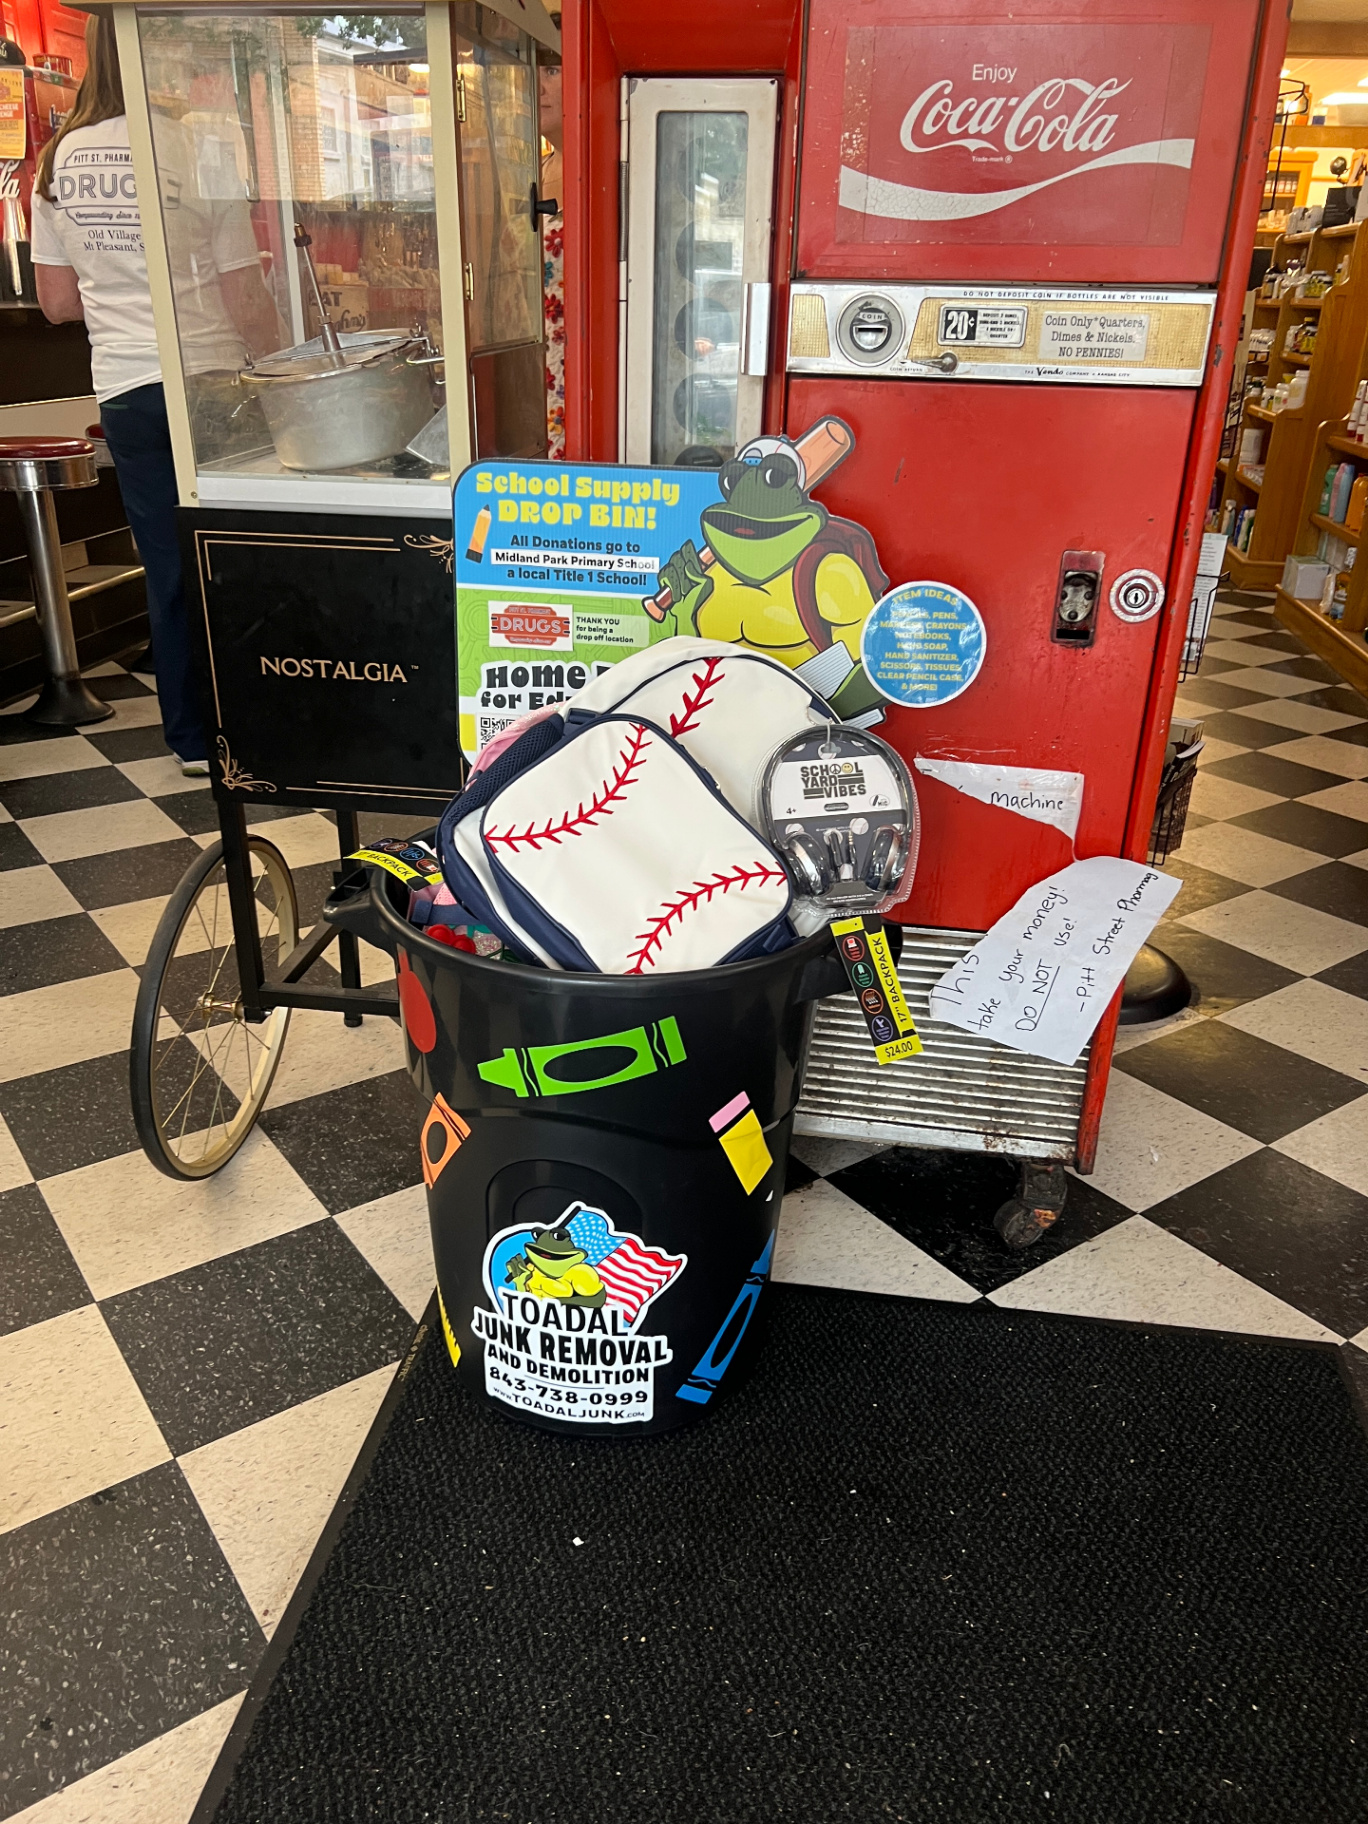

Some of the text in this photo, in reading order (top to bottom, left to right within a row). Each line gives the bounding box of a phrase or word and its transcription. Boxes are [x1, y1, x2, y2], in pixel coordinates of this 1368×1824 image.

[972, 64, 1017, 82] Enjoy
[900, 77, 1133, 153] Coca-Cola
[74, 153, 88, 163] PITT
[91, 153, 102, 163] ST.
[88, 229, 142, 242] Old Village
[83, 241, 95, 251] Mt
[97, 241, 137, 252] Pleasant,
[945, 311, 975, 340] 20¢
[1045, 315, 1067, 327] Coin
[1100, 316, 1146, 329] Quarters,
[1051, 331, 1081, 342] Dimes
[1084, 331, 1094, 342] &
[1058, 347, 1124, 359] NO PENNIES!
[1036, 367, 1064, 376] Vendo
[476, 471, 680, 506] School Supply
[498, 500, 657, 530] DROP BIN!
[510, 534, 641, 554] All Donations go to
[495, 551, 655, 571] Midland Park Primary School
[507, 566, 647, 586] a local Title 1 School!
[893, 588, 958, 606] ITEM IDEAS
[576, 616, 620, 626] THANK YOU
[932, 611, 958, 620] PENS,
[500, 616, 561, 634] DRUGS
[576, 625, 587, 633] for
[588, 625, 608, 634] being
[576, 634, 634, 643] drop off location
[924, 642, 948, 651] SOAP,
[885, 652, 910, 660] HAND
[260, 656, 408, 683] NOSTALGIA
[486, 664, 586, 690] Home
[877, 672, 905, 680] CLEAR
[906, 672, 938, 680] PENCIL
[901, 682, 907, 690] &
[480, 690, 572, 710] for Ed
[801, 775, 838, 789] YARD
[823, 784, 867, 798] VIBES
[786, 807, 797, 815] 4+
[1092, 917, 1125, 955] Street
[967, 886, 1068, 1030] take your money!
[872, 937, 901, 1004] BACKPACK
[1015, 1005, 1038, 1031] DO
[1032, 958, 1053, 994] NOT
[885, 1040, 913, 1058] $24.00
[503, 1291, 629, 1337] TOADAL
[475, 1312, 532, 1356] JUNK
[540, 1332, 667, 1367] REMOVAL
[487, 1344, 649, 1386] AND DEMOLITION
[489, 1366, 648, 1406] 843-738-0999
